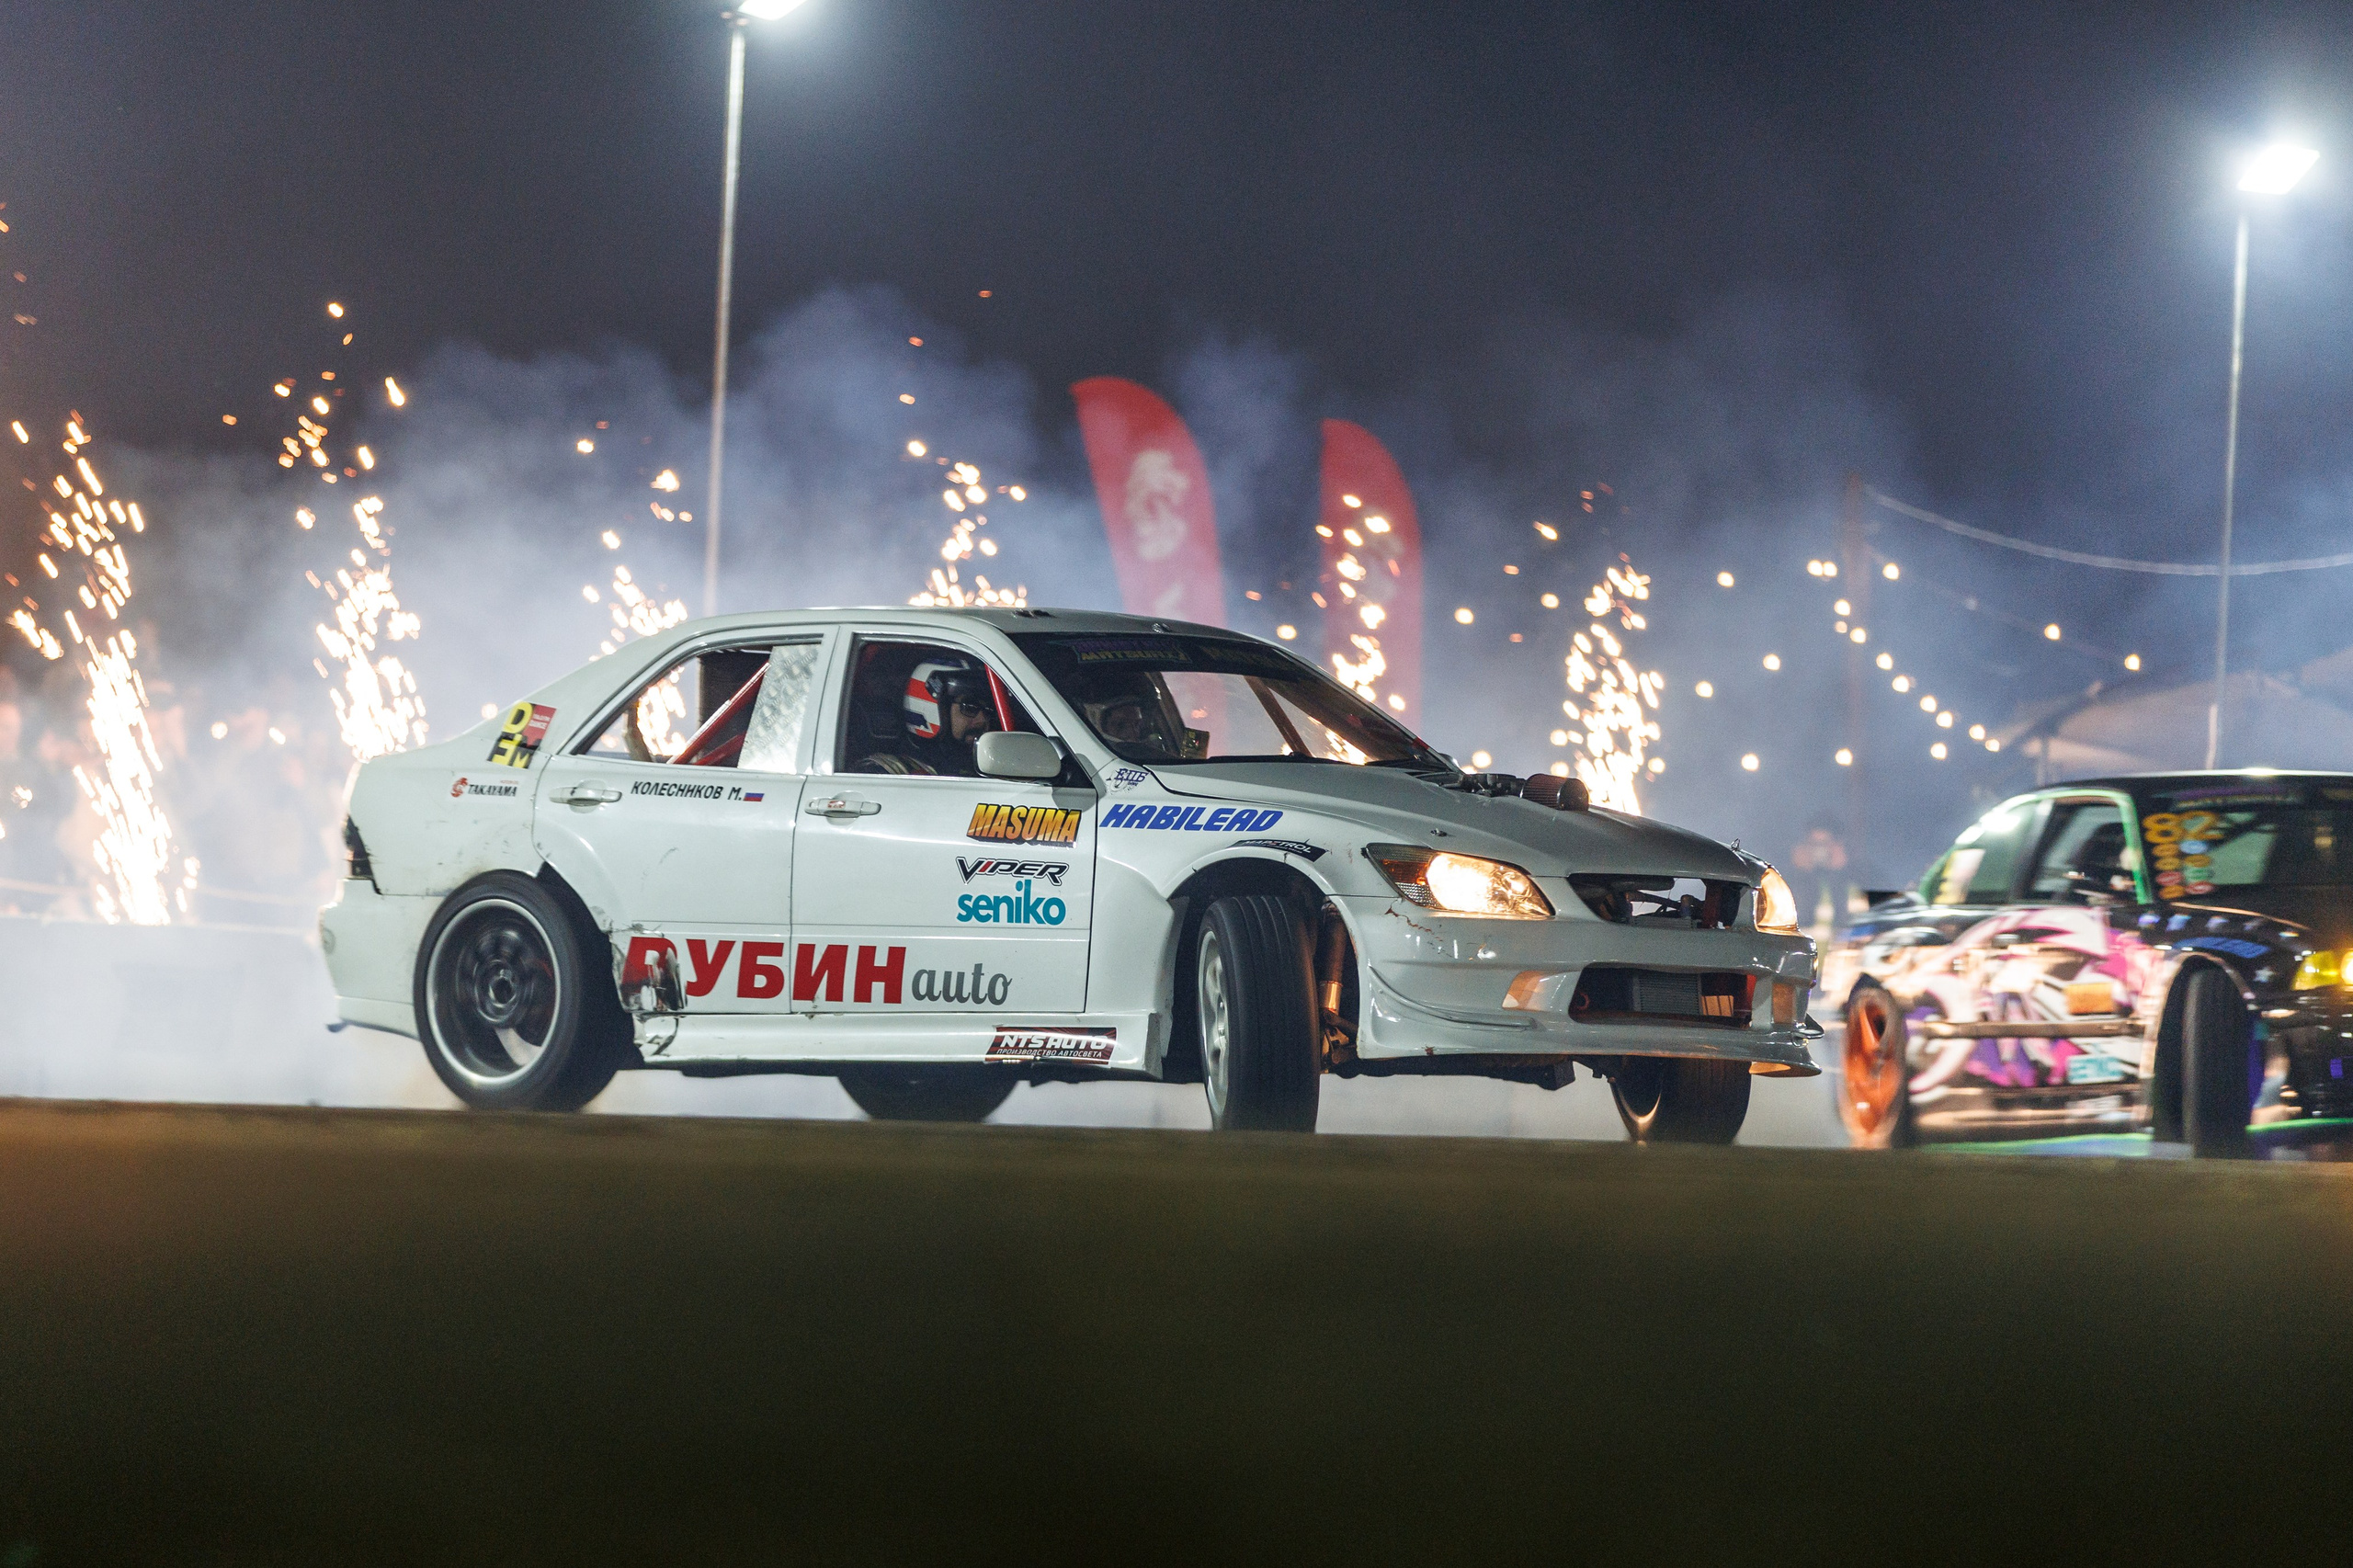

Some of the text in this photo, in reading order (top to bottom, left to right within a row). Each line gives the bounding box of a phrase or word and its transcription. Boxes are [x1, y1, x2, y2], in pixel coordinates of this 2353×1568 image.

[468, 784, 517, 797] TAKAYAMA
[631, 781, 723, 799] КОЛЕСНИКОВ
[966, 803, 1082, 846] MASUMA
[1099, 804, 1284, 832] HABILEAD
[956, 857, 1069, 886] VIPER
[956, 879, 1066, 926] seniko
[912, 963, 1013, 1006] auto
[996, 1048, 1102, 1058] ПРОИЗВОДСТВО АВТОСВЕТА
